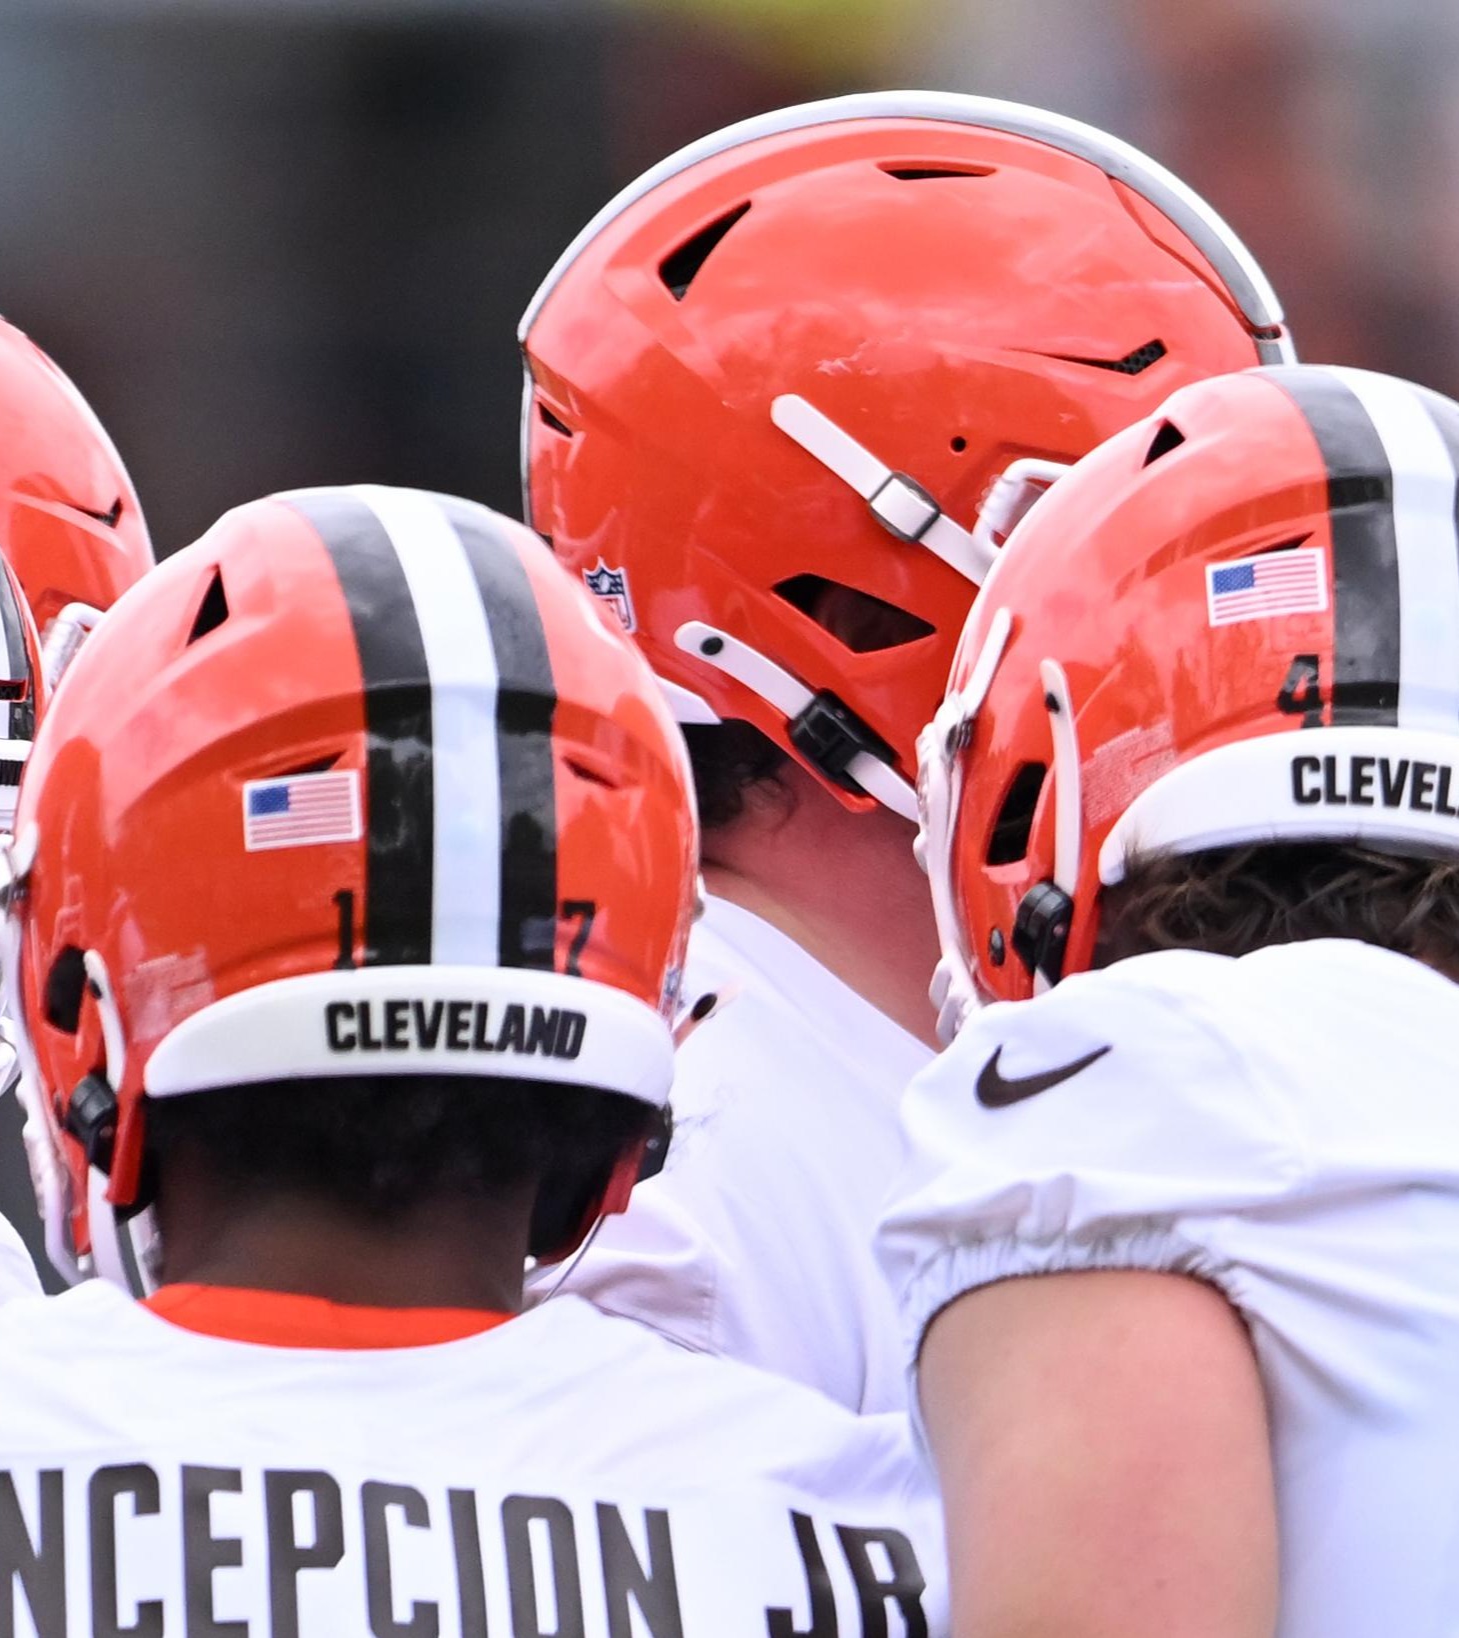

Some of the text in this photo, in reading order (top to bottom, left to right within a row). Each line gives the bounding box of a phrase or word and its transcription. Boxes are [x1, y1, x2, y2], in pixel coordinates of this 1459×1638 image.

[1276, 653, 1325, 728] 4
[1290, 754, 1459, 818] CLEVEL
[324, 1000, 588, 1060] CLEVELAND
[765, 1508, 928, 1638] JR
